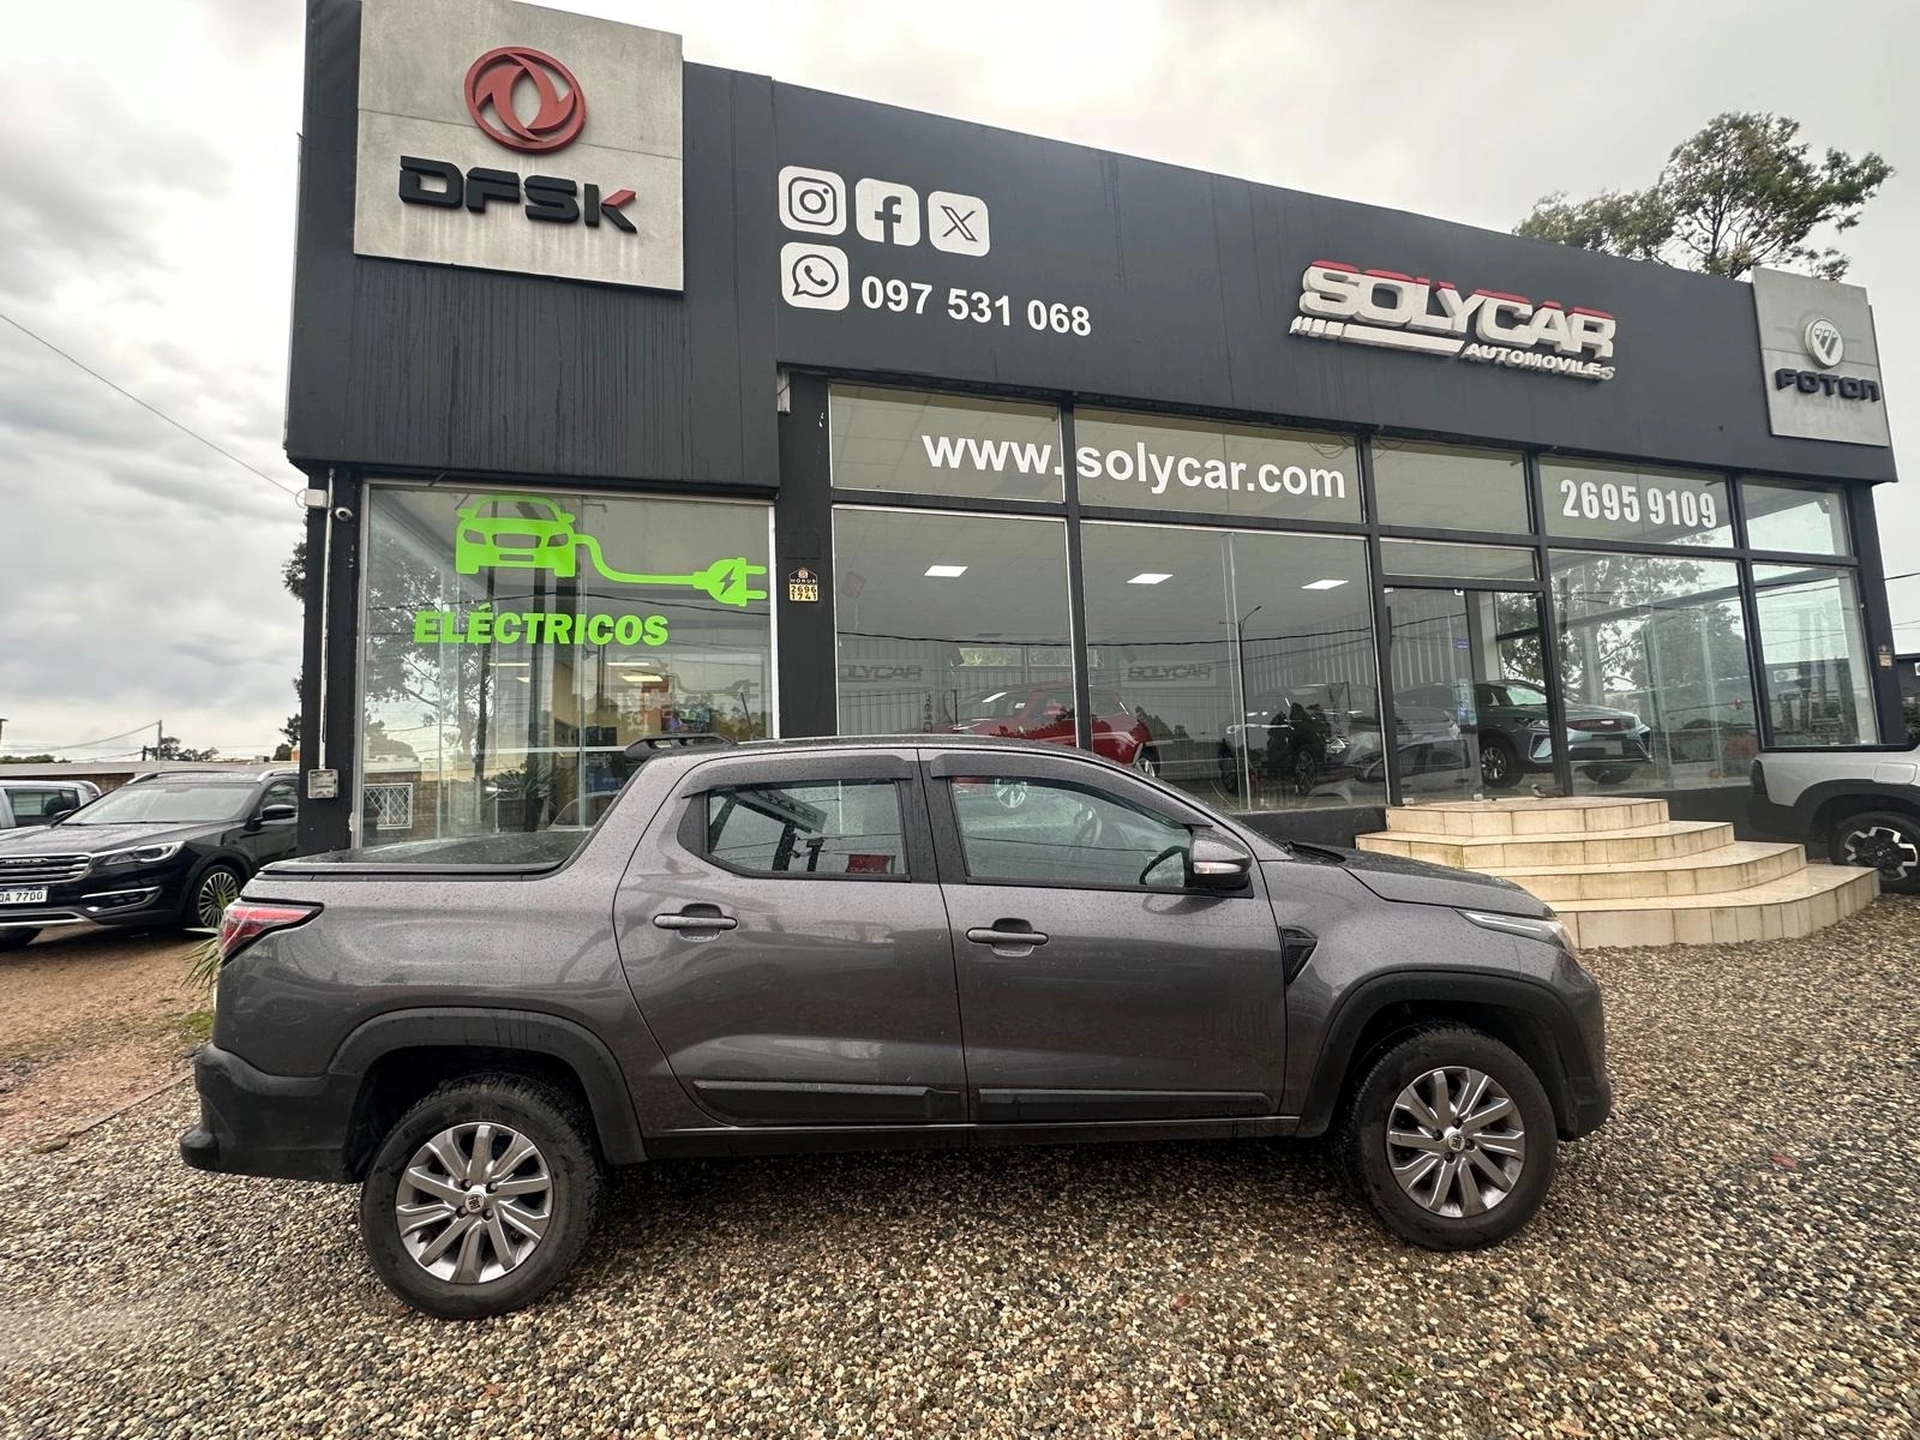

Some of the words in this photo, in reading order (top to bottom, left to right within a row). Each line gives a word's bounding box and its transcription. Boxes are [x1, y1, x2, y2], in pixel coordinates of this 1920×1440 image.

[399, 155, 638, 235] DFSK
[861, 275, 933, 315] 097
[947, 288, 1011, 327] 531
[1027, 299, 1092, 337] 068
[1299, 259, 1617, 360] SOLYCAR
[1459, 343, 1617, 381] AUTOMOVILES
[1774, 367, 1881, 403] FOTON
[921, 434, 1346, 499] www.solycar.com
[1560, 478, 1640, 523] 2695
[1647, 487, 1717, 528] 9109
[791, 585, 816, 593] 2696
[413, 602, 669, 646] ELÉCTRICOS
[16, 891, 43, 902] 7700
